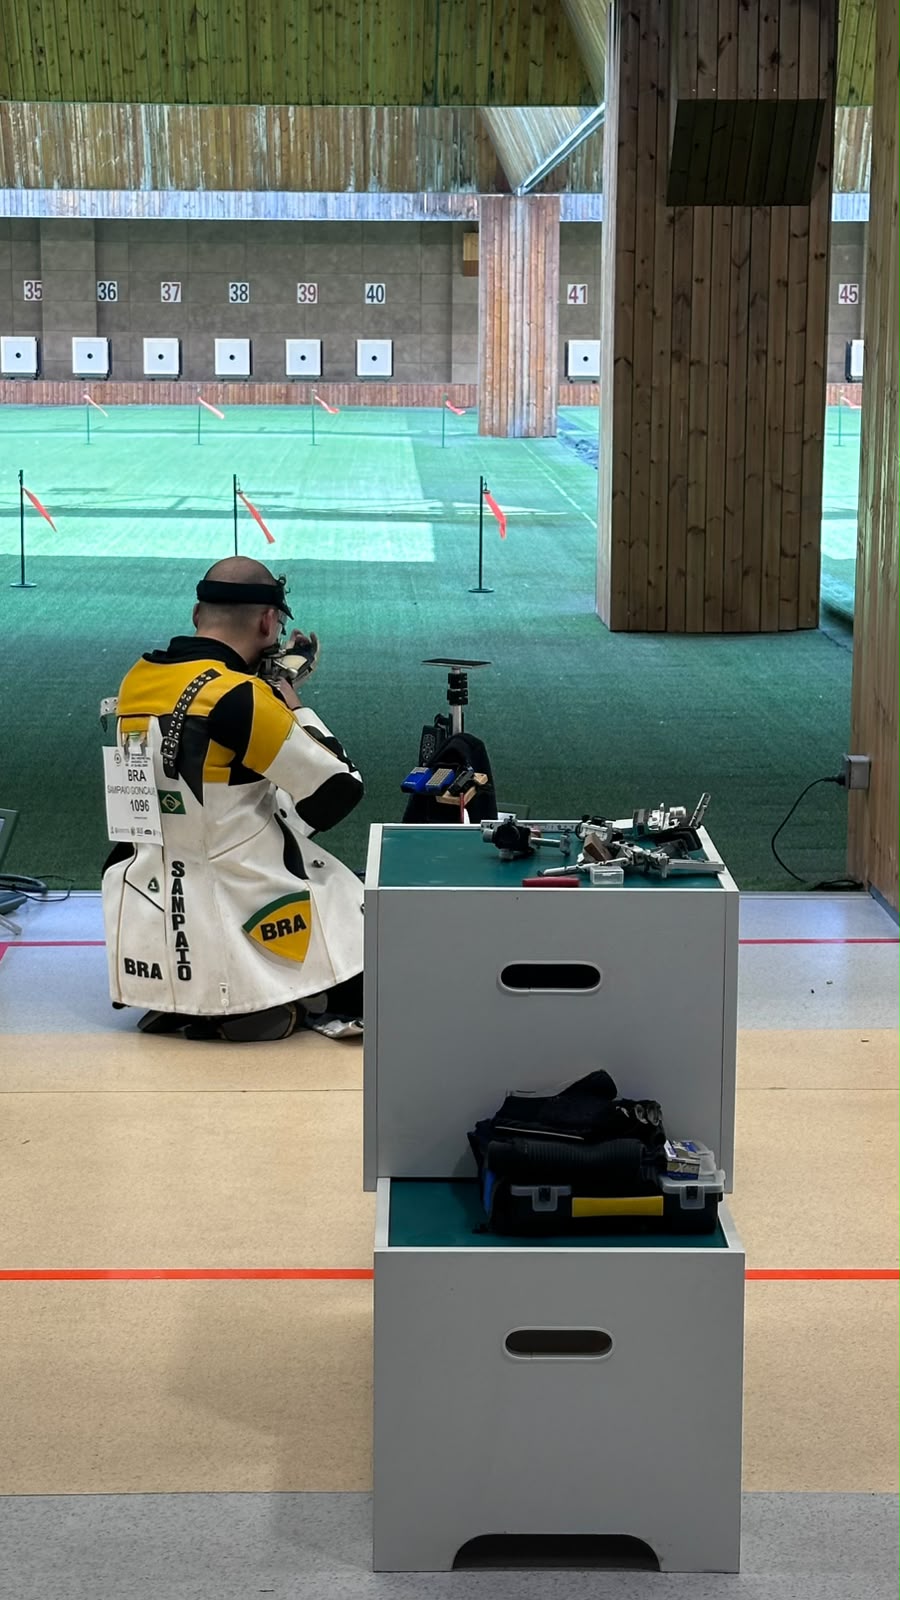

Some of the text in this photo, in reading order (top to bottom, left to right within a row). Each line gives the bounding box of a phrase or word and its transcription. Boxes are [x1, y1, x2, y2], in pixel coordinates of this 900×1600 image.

[24, 281, 42, 301] 35
[98, 281, 117, 301] 36
[161, 282, 181, 302] 37
[230, 283, 249, 303] 38
[298, 283, 317, 303] 39
[366, 284, 385, 304] 40
[567, 284, 587, 304] 41
[838, 284, 859, 304] 45
[128, 769, 147, 782] BRA
[130, 799, 150, 812] 1096
[171, 860, 192, 981] SAMPAIO
[260, 913, 307, 942] BRA
[124, 957, 163, 980] BRA
